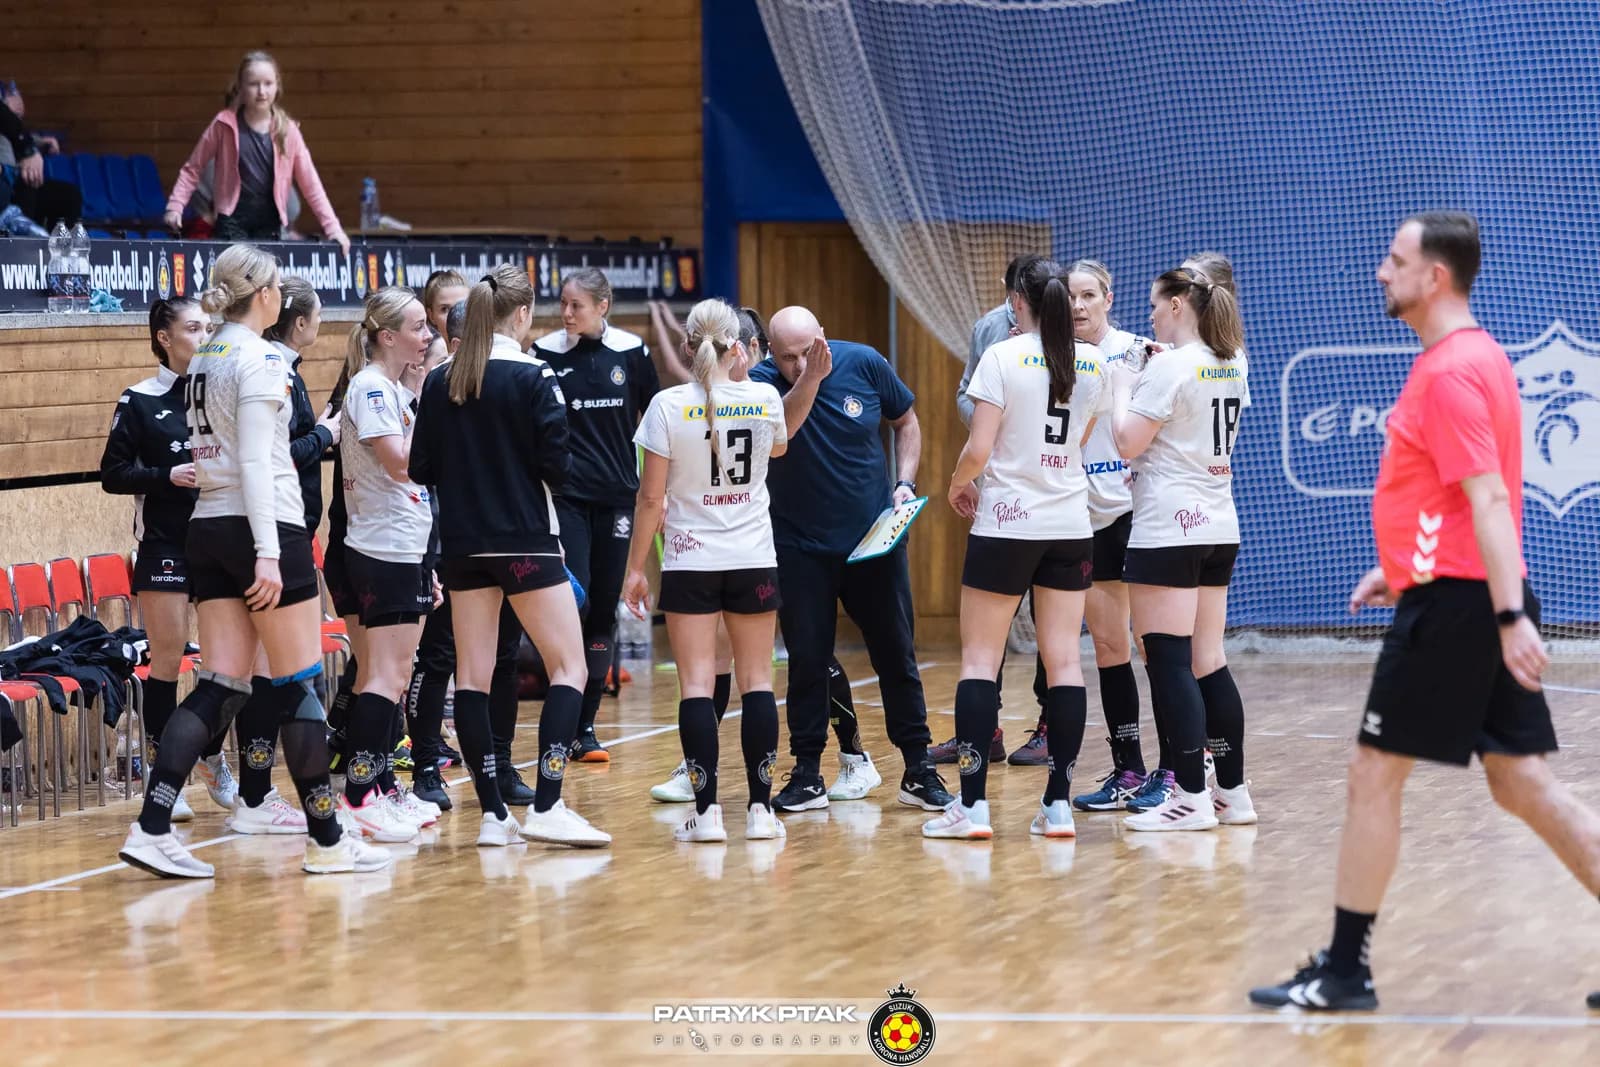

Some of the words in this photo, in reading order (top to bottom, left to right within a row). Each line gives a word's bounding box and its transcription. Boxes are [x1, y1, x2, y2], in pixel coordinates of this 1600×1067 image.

[1, 248, 154, 303] www.kandball.pl
[1040, 357, 1096, 373] LTAN
[583, 398, 624, 408] SUZUKI
[716, 405, 763, 417] WIATAN
[1045, 383, 1070, 445] 5
[1211, 397, 1240, 456] 18
[704, 428, 752, 486] 13
[1085, 460, 1128, 475] UZUK
[703, 492, 751, 505] GLIWIŃSKA
[993, 497, 1021, 519] Pink
[998, 510, 1031, 530] power
